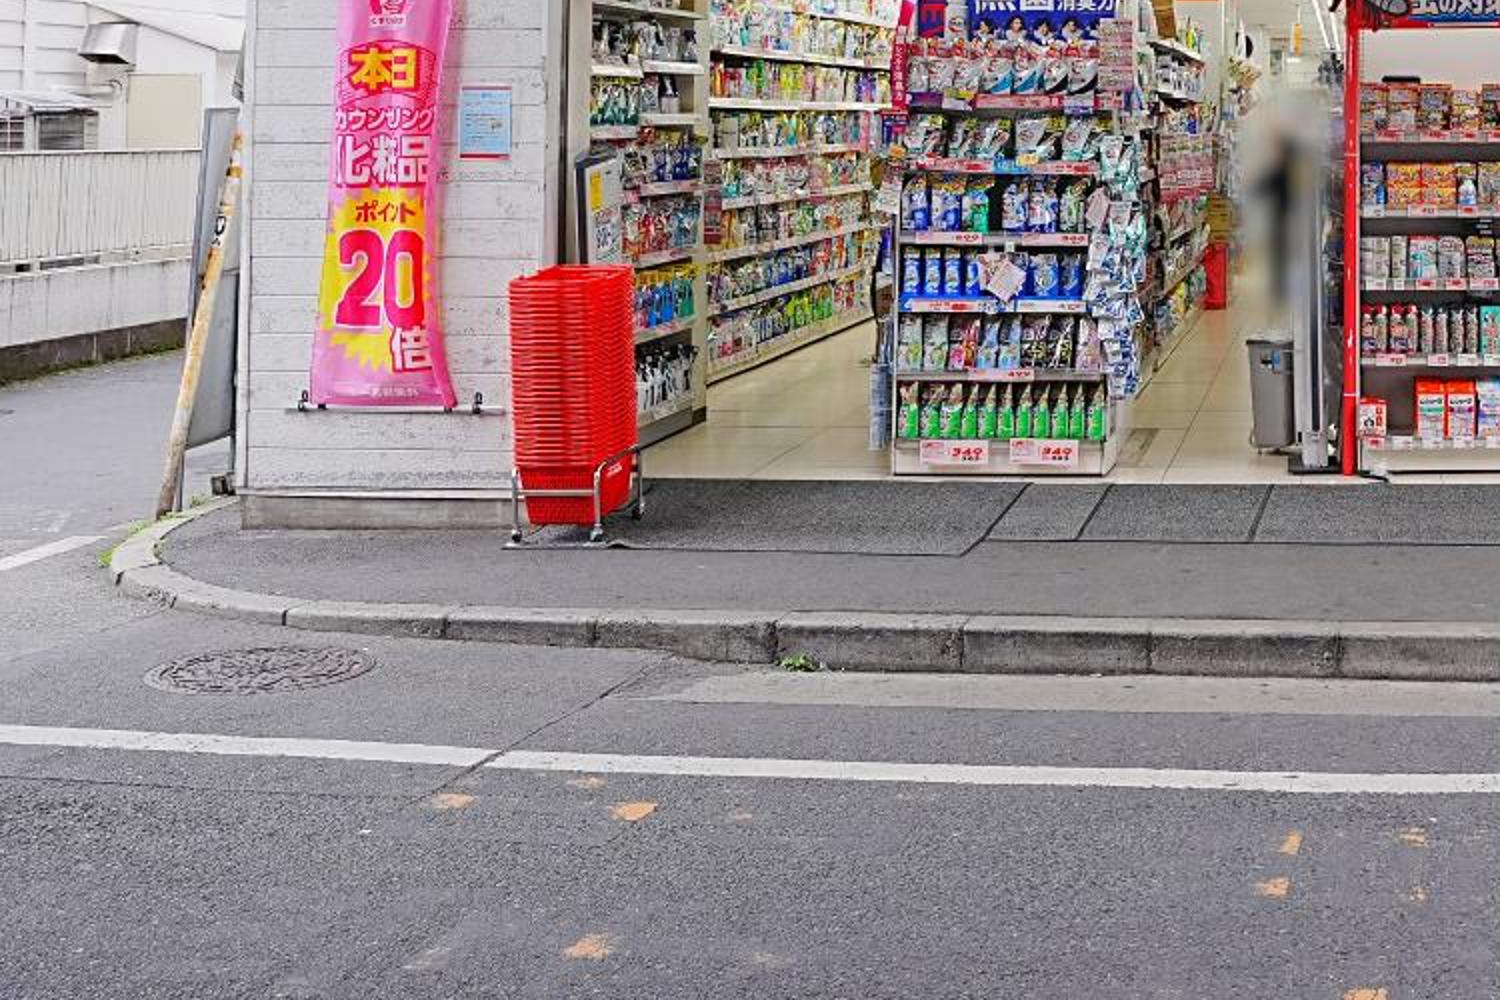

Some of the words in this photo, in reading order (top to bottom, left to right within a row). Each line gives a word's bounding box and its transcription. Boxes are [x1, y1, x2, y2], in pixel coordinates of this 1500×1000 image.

[351, 48, 417, 89] 本日
[336, 229, 425, 328] 20
[392, 326, 433, 371] 倍
